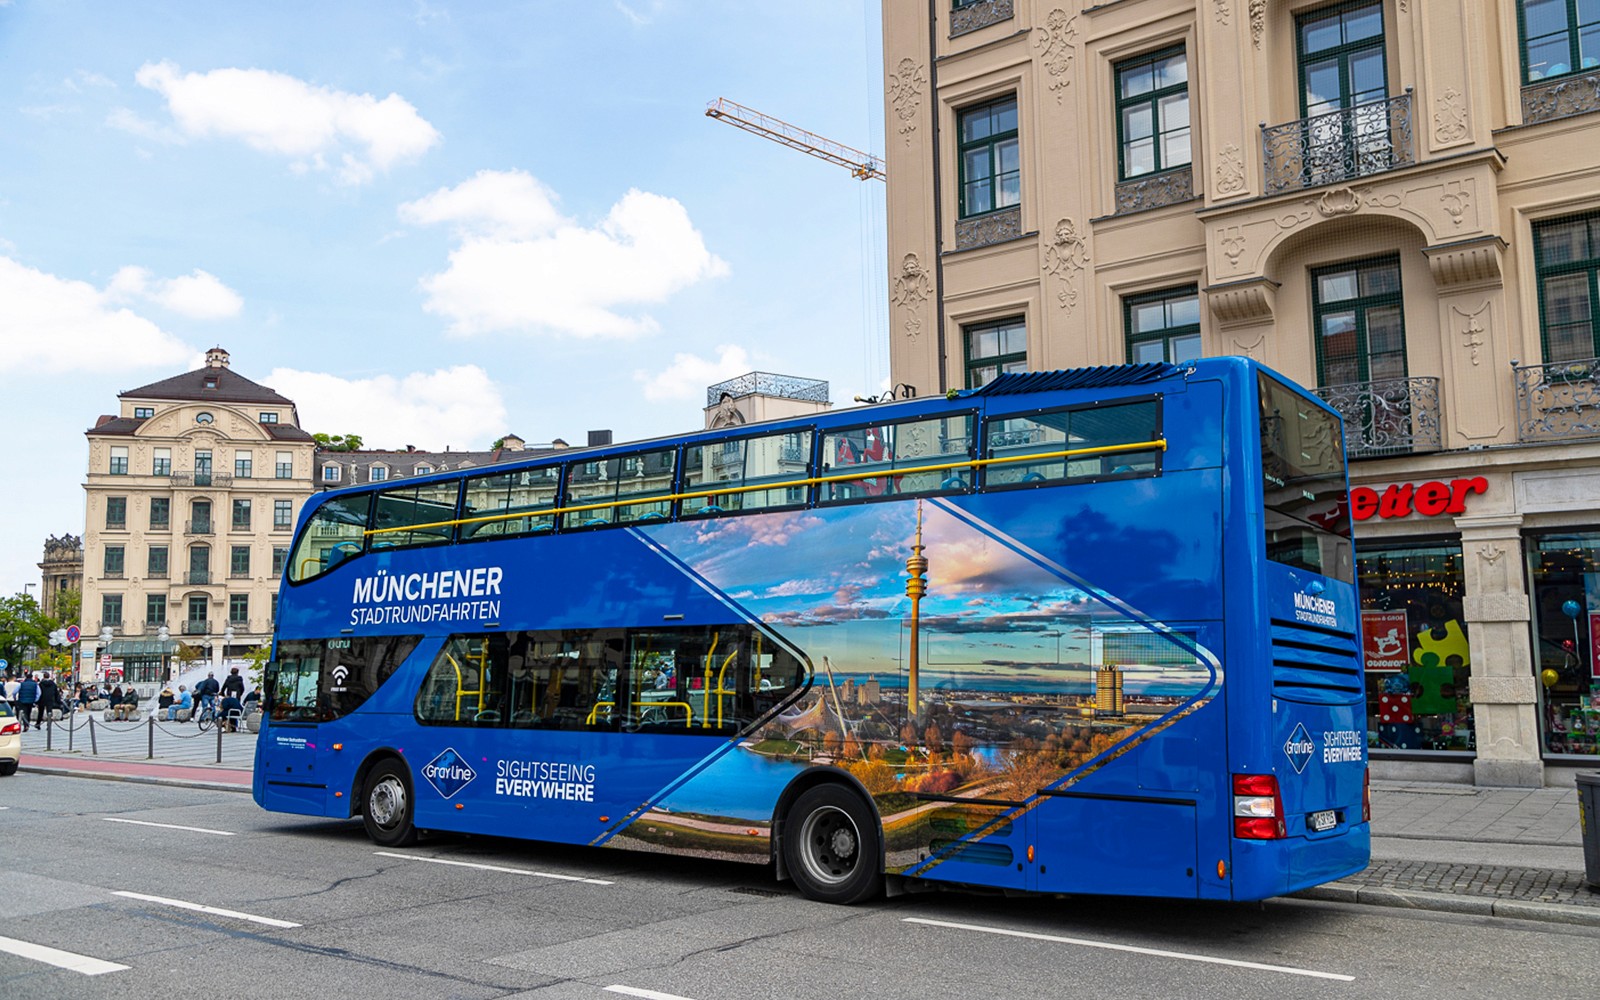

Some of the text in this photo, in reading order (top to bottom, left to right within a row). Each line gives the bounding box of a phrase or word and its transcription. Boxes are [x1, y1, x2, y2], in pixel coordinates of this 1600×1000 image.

[353, 566, 502, 603] MÜNCHENER
[350, 601, 501, 625] STADTRUNDFAHRTEN
[1294, 591, 1336, 617] MÜNCHENER
[1323, 731, 1361, 747] SIGHTSEEING
[1323, 747, 1362, 763] EVERYWHERE
[496, 760, 596, 783] SIGHTSEEING
[495, 779, 594, 802] EVERYWHERE
